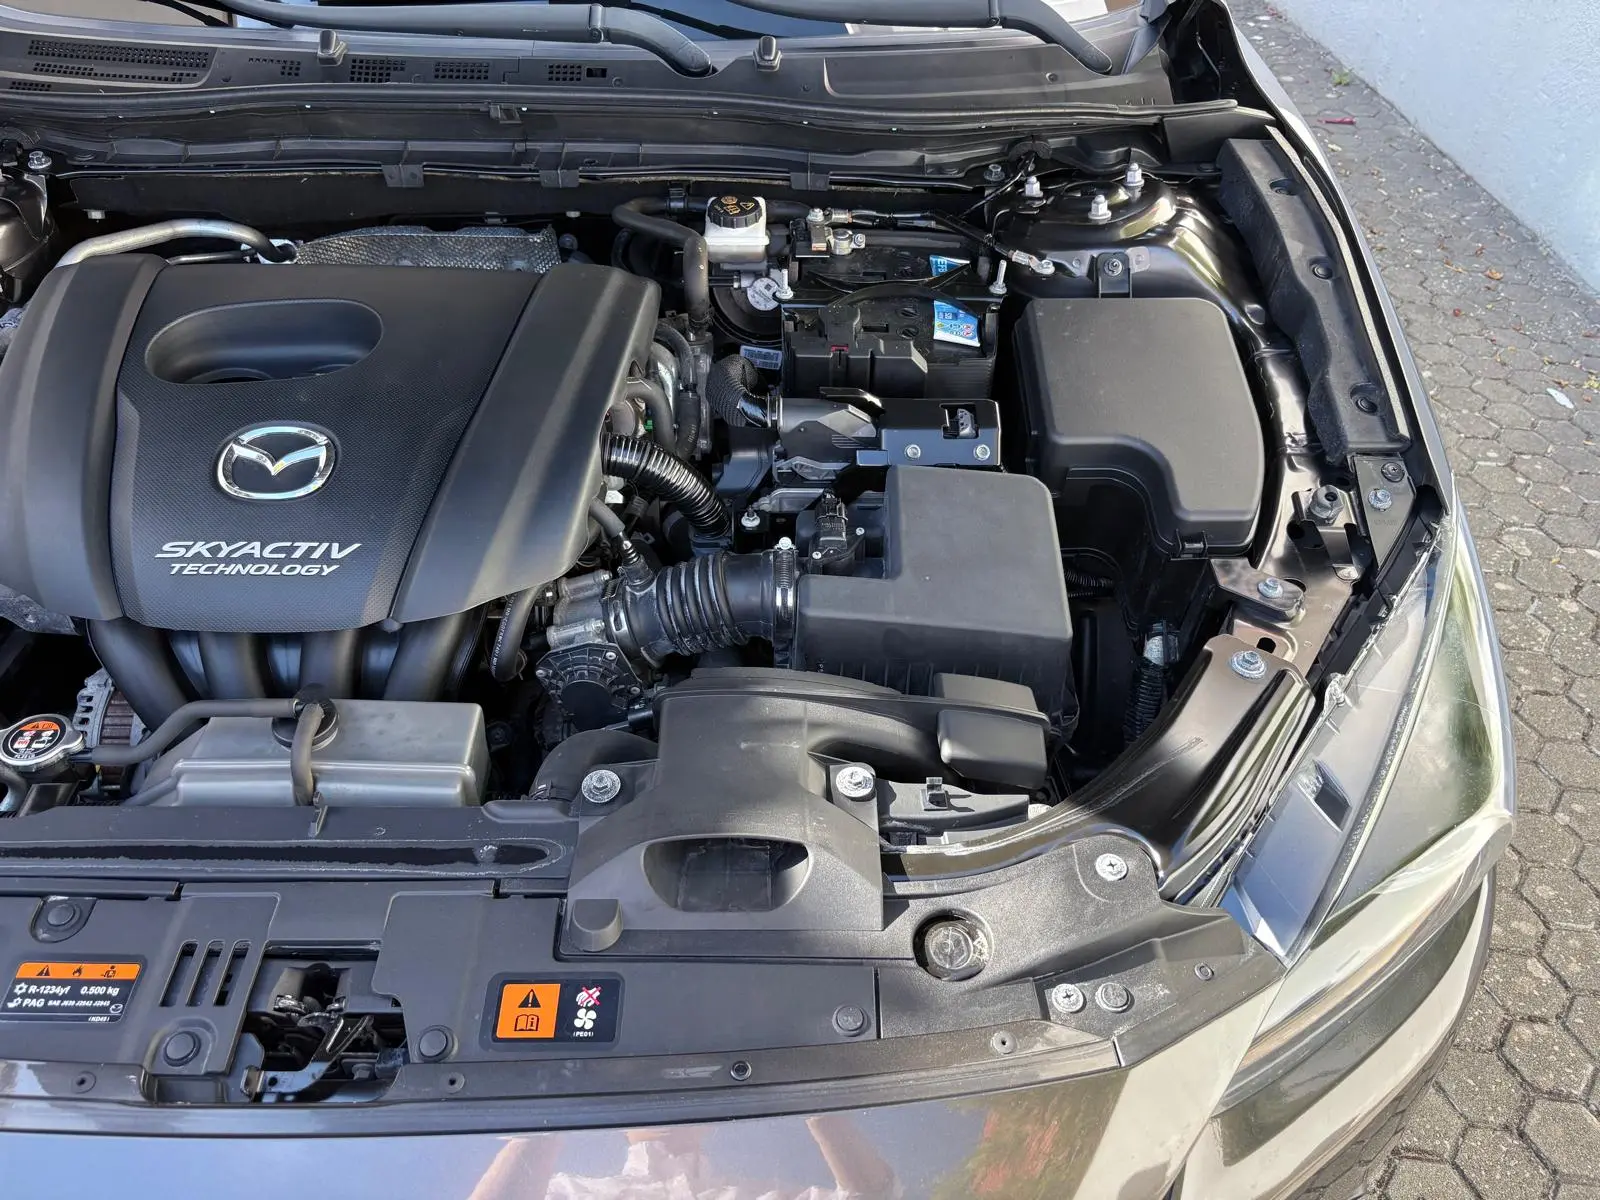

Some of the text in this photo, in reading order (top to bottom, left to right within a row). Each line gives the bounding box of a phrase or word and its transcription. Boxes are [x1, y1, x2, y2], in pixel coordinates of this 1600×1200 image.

[154, 541, 362, 559] SKYACTIV
[170, 563, 340, 576] TECHNOLOGY
[28, 985, 120, 996] R-1234yf 0.500 kg
[22, 998, 45, 1008] PAG
